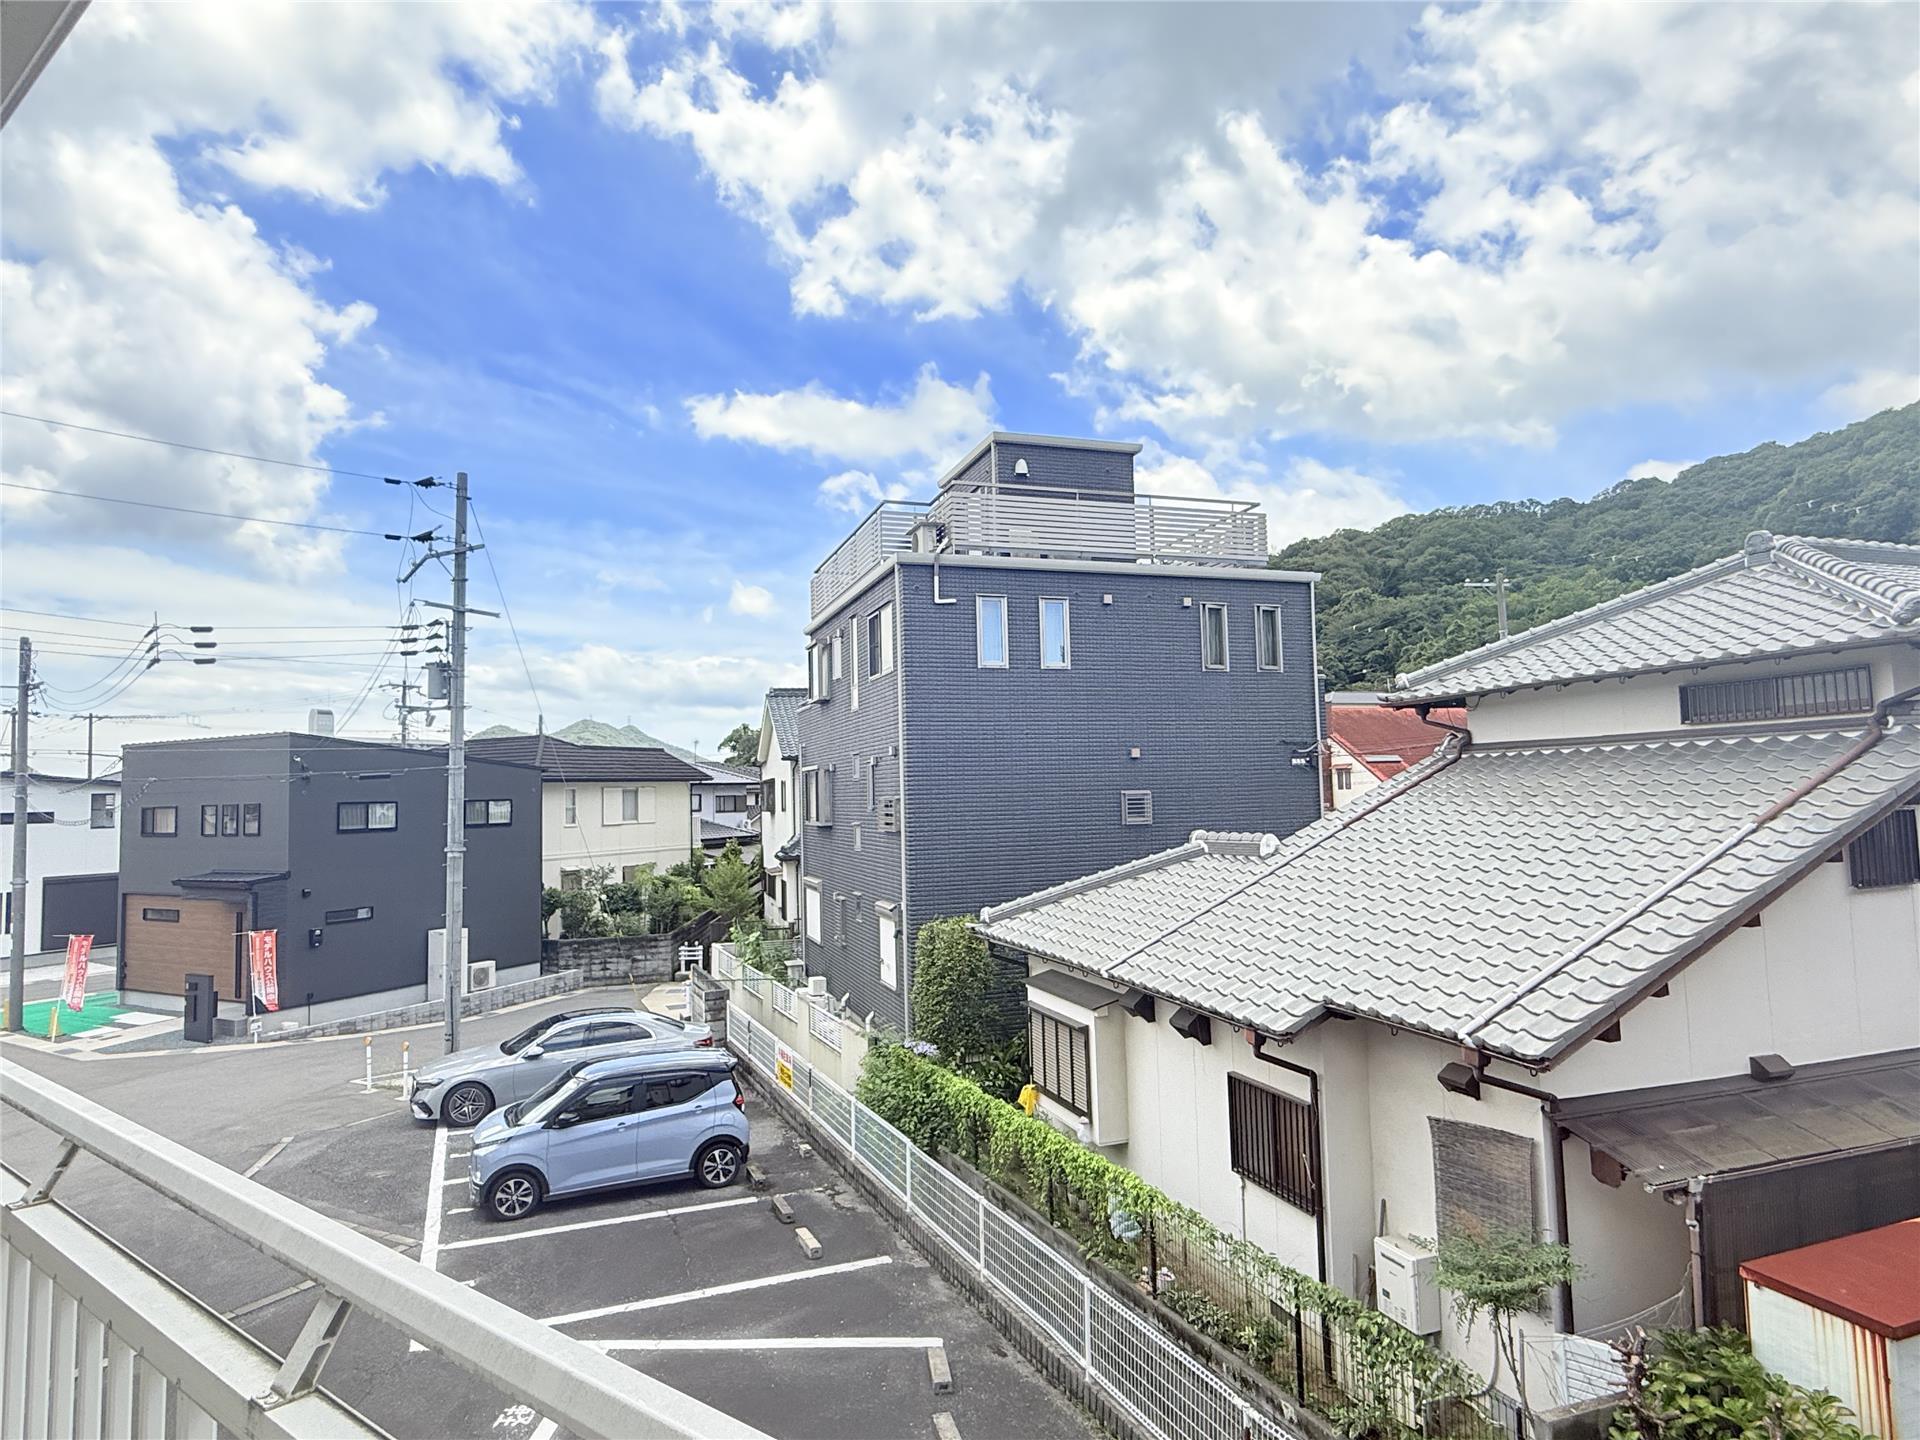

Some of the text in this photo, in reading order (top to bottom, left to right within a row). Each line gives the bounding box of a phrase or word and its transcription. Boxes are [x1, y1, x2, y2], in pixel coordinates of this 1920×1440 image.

[263, 936, 275, 1001] モデルハウス公開中
